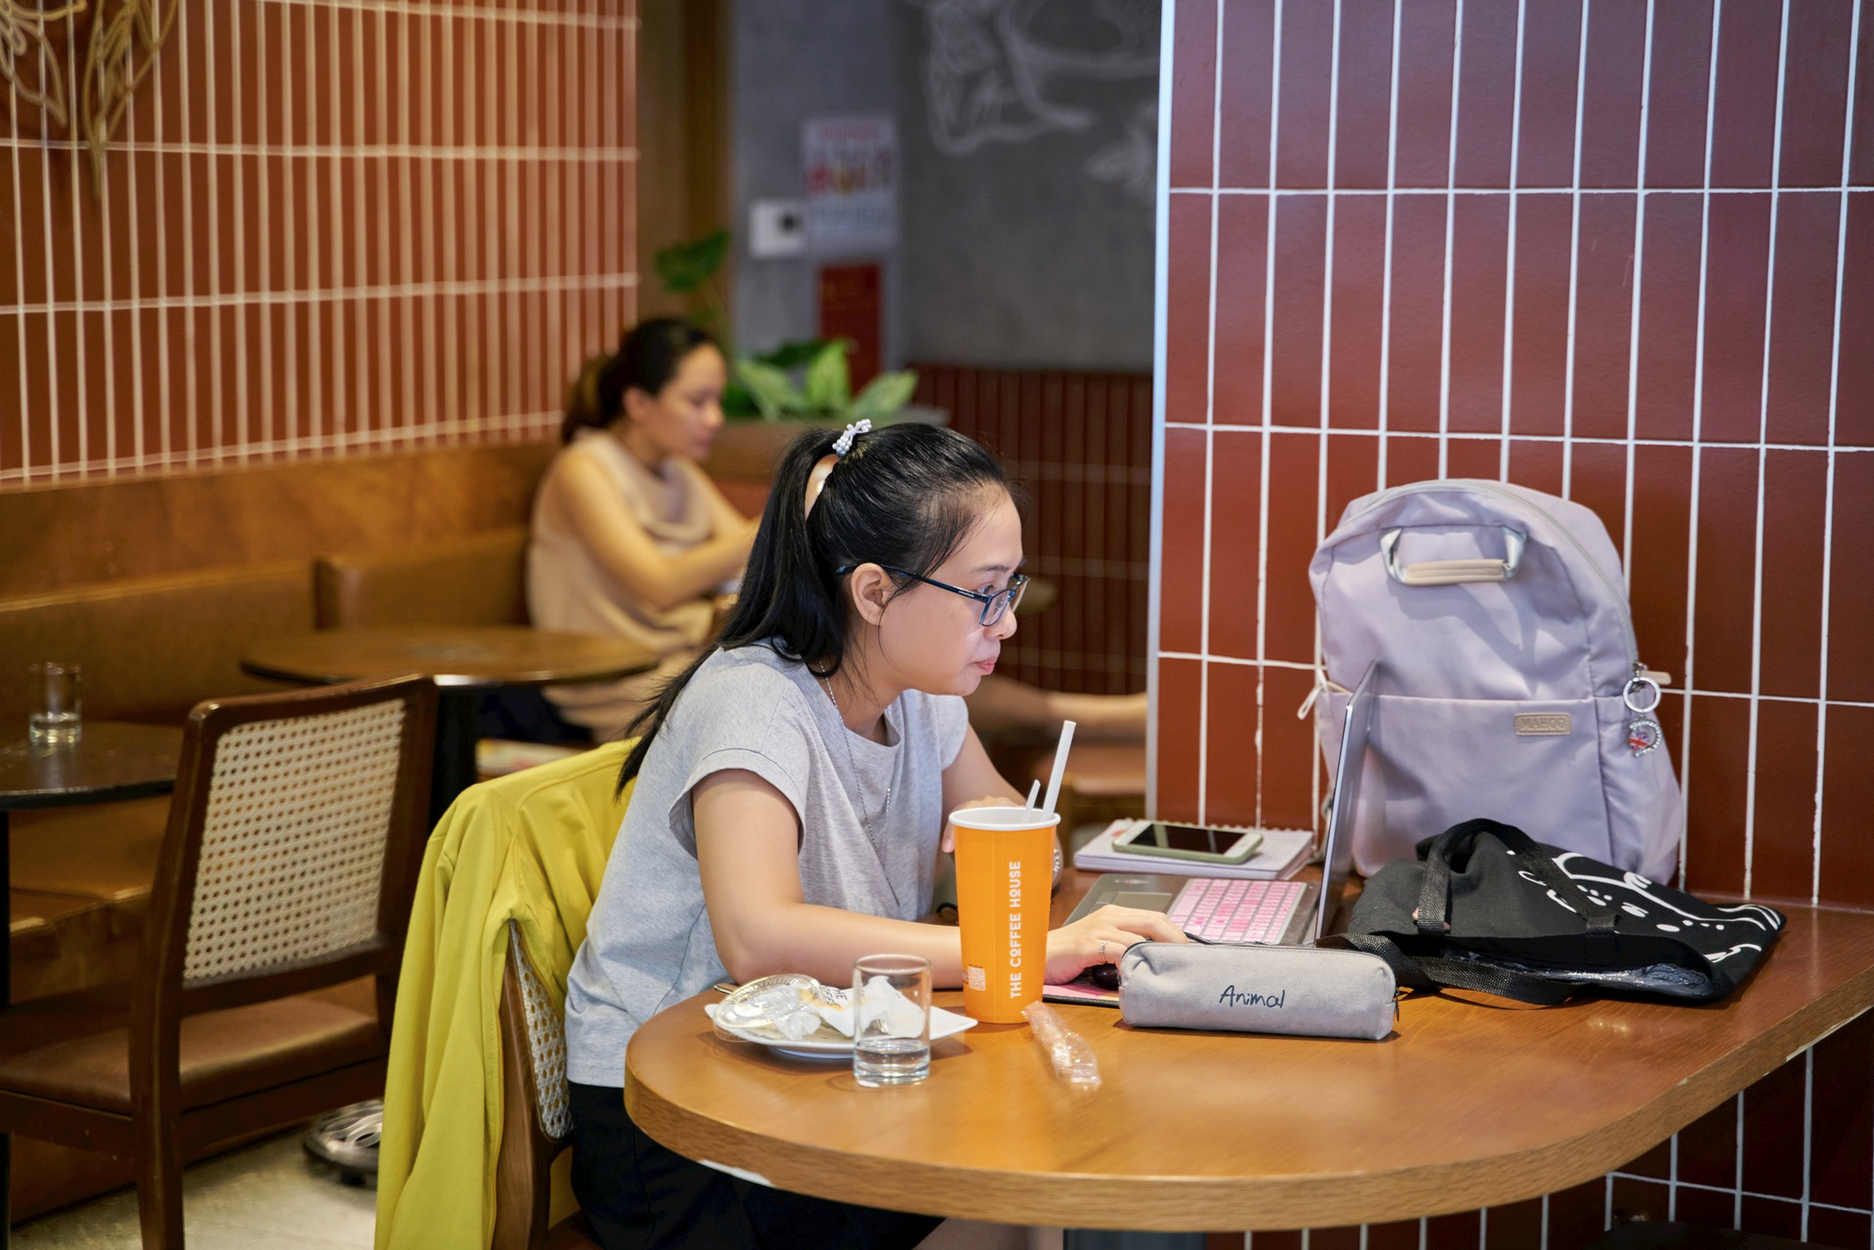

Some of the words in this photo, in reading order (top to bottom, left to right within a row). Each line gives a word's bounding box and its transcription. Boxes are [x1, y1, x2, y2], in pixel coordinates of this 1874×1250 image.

[1009, 861, 1021, 908] HOUSE
[1009, 913, 1022, 968] COFFEE
[1010, 972, 1022, 999] THE
[1219, 985, 1286, 1009] Animal
